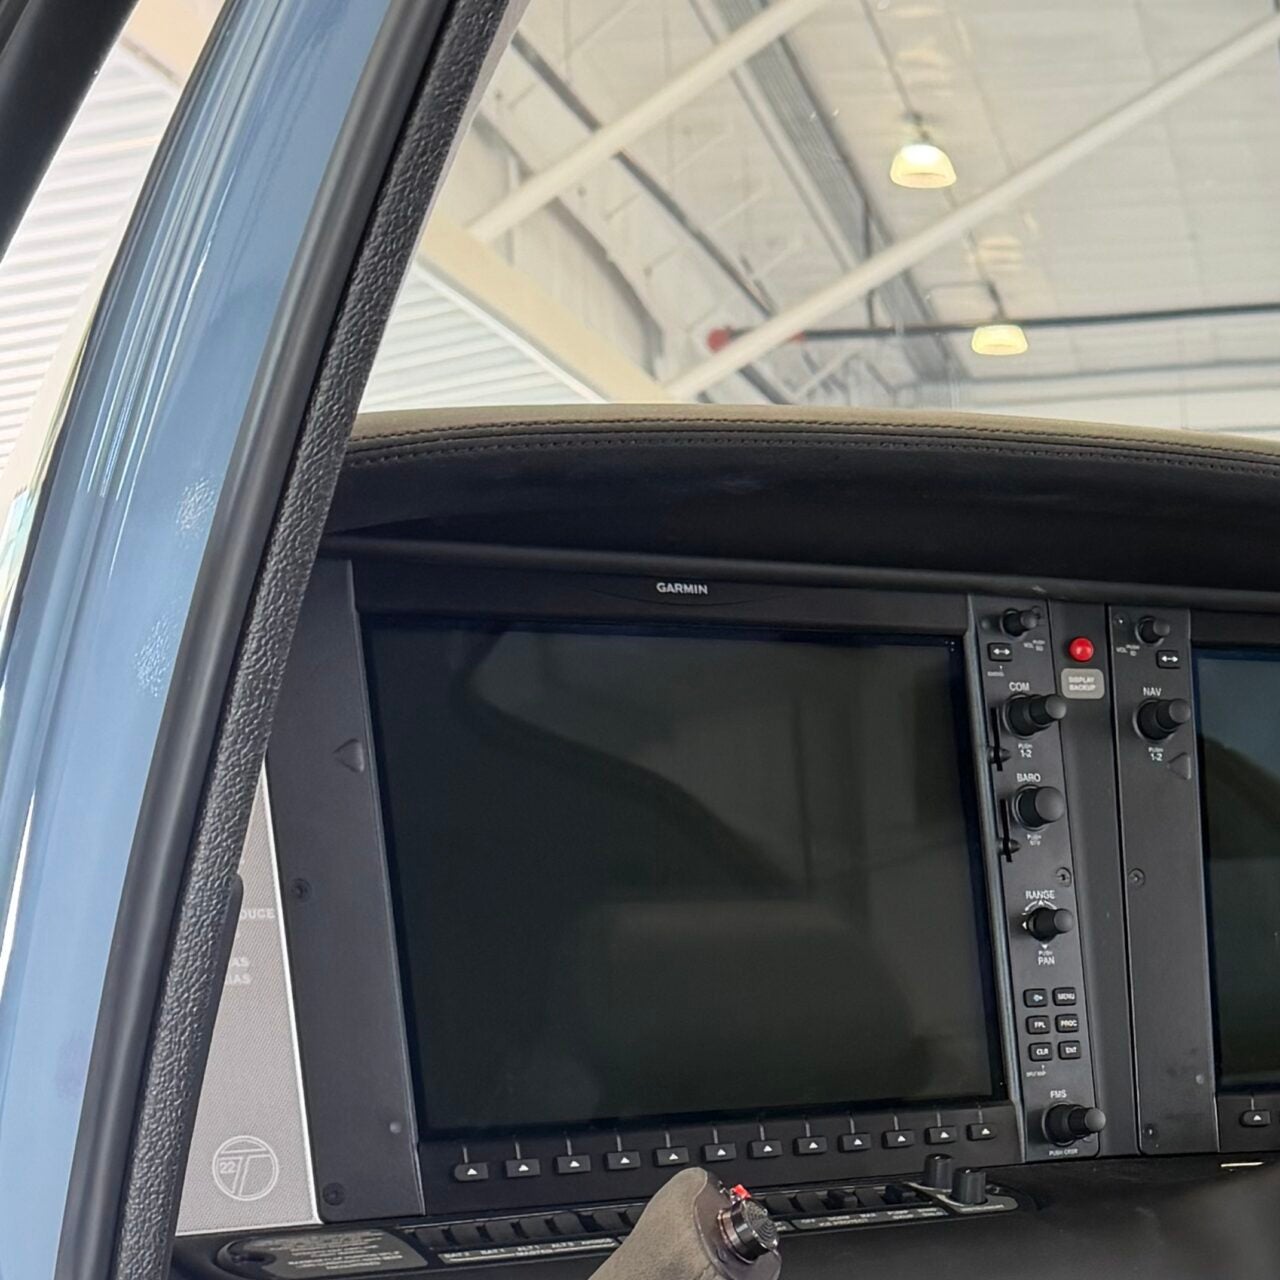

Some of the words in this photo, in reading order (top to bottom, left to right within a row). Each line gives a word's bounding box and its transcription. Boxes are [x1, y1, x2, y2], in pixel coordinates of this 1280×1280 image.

[656, 582, 708, 595] GARMIN
[1009, 682, 1030, 691] COM
[1143, 687, 1161, 696] NAV
[1016, 773, 1041, 782] BARO
[1025, 890, 1056, 900] RANGE
[1038, 956, 1056, 966] PAN
[1034, 1021, 1046, 1029] FPL
[1060, 1019, 1078, 1027] PROC
[1036, 1047, 1049, 1056] CLR
[1050, 1089, 1068, 1098] FMS
